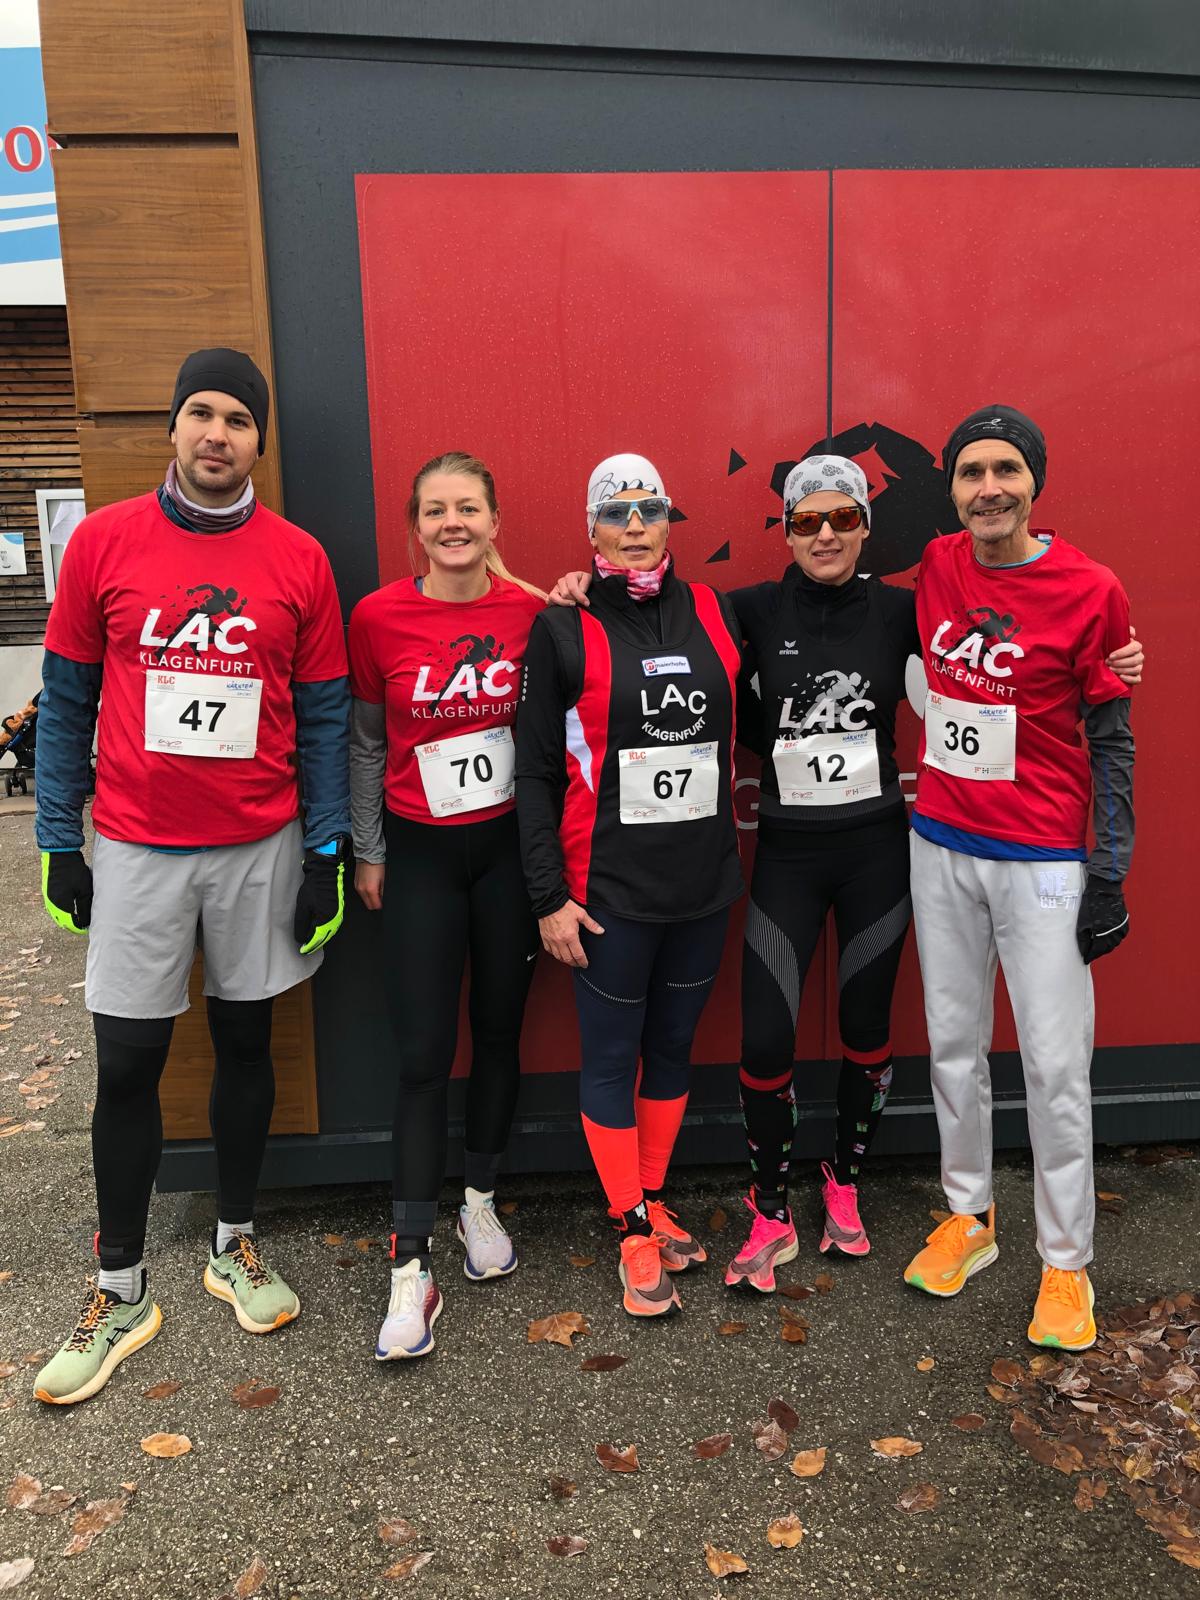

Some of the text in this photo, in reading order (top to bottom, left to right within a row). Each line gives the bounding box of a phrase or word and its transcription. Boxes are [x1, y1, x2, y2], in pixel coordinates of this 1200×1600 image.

[139, 609, 257, 654] LAC
[139, 651, 255, 675] KLAGENFURT
[930, 620, 1024, 678] LAC
[157, 675, 175, 685] KLC
[411, 659, 517, 701] LAC
[411, 700, 519, 719] KLAGENFURT
[640, 683, 707, 716] LAC
[778, 697, 876, 731] LAC
[179, 700, 227, 733] 47
[641, 716, 706, 742] KLAGENFURT
[628, 750, 647, 760] KLC
[944, 721, 980, 756] 36
[450, 754, 493, 788] 70
[653, 768, 693, 800] 67
[807, 754, 848, 783] 12
